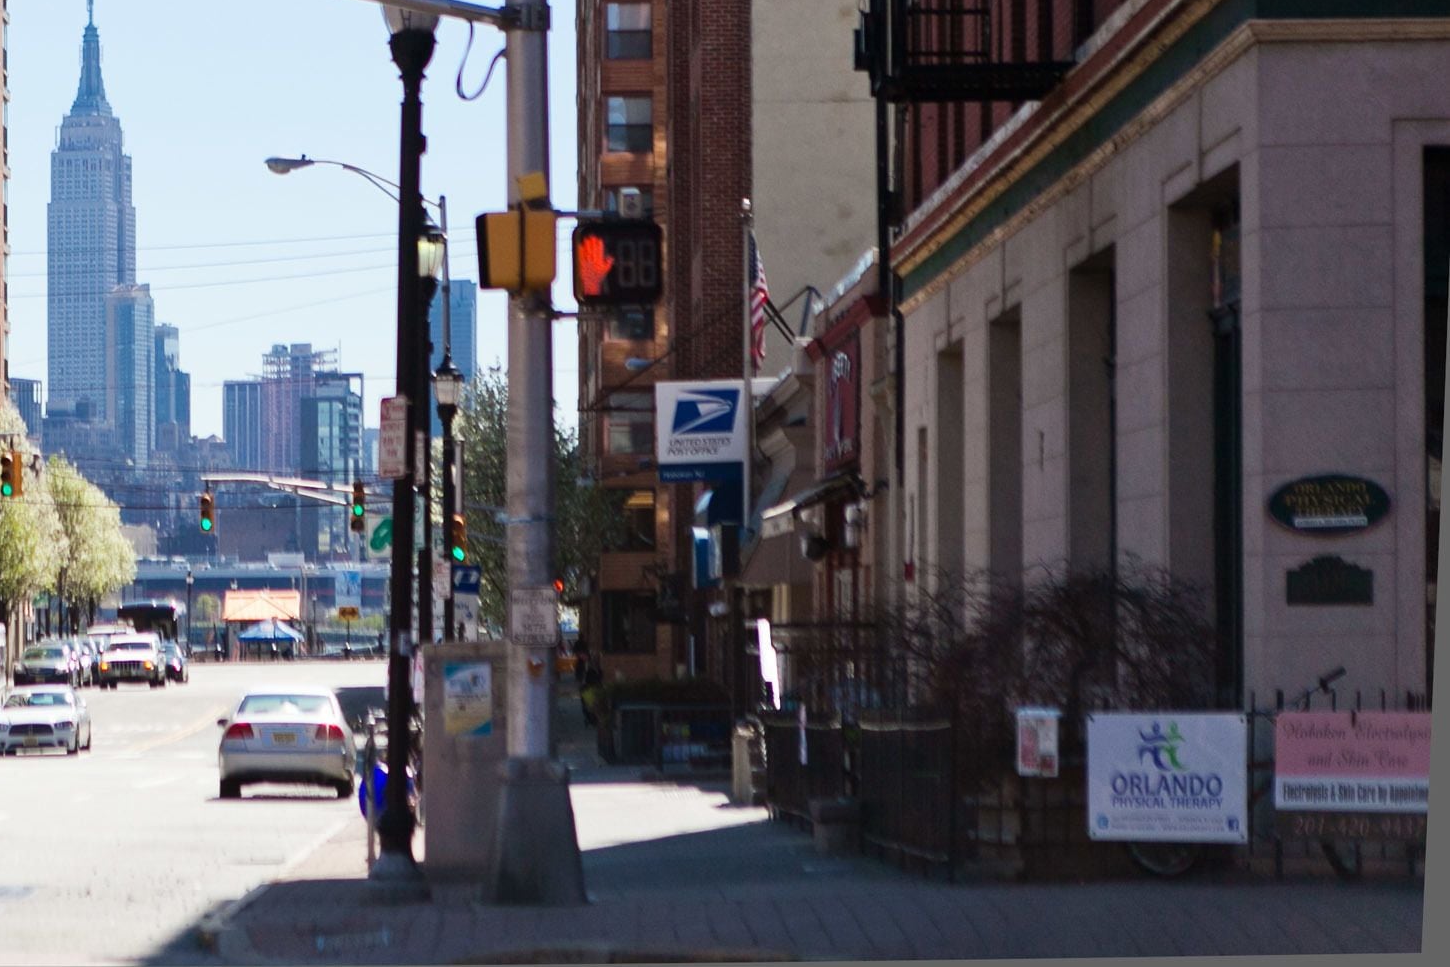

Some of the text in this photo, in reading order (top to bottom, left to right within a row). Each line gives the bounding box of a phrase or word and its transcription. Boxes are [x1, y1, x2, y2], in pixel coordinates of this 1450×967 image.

[669, 437, 731, 447] UNITED STATES
[668, 446, 718, 455] POST OFFICE
[1293, 482, 1367, 493] ORLANDO
[1284, 494, 1375, 506] PHYSICAL
[1295, 506, 1367, 517] THERAPY
[1307, 752, 1332, 768] and
[1337, 750, 1369, 768] Skin
[1111, 773, 1223, 797] ORLANDO
[1283, 783, 1329, 803] Electrolysis
[1338, 784, 1355, 803] Skin
[1357, 785, 1376, 803] Care
[1112, 797, 1223, 810] PHYSICAL THERAPY
